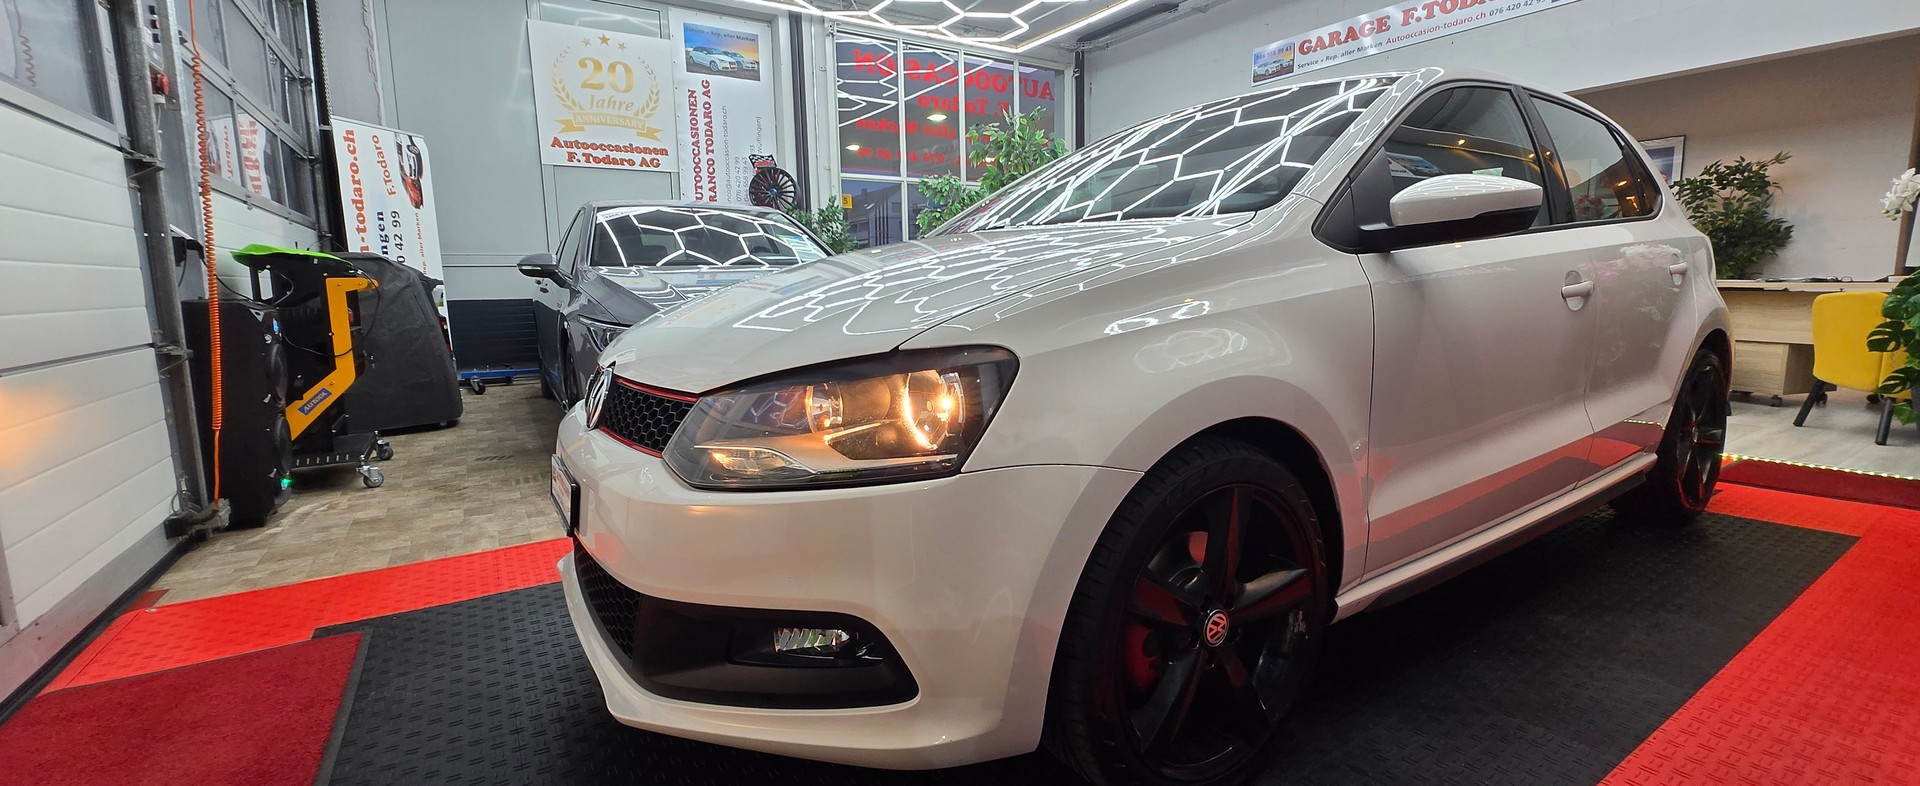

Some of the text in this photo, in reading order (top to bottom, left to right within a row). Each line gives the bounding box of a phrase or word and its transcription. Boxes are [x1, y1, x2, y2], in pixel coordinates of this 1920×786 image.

[1297, 59, 1319, 69] Service
[1325, 54, 1340, 62] Rep.
[1341, 49, 1356, 58] aller
[1356, 42, 1383, 53] Marken
[1385, 11, 1486, 45] Autooccasion-todaro.ch
[1489, 7, 1504, 17] 076
[1505, 2, 1521, 12] 420
[1298, 0, 1487, 55] GARAGE F.TOD
[577, 56, 634, 94] 20
[701, 79, 711, 99] AG
[589, 94, 635, 112] Jahre
[575, 113, 645, 130] ANNIVERSARY
[702, 101, 714, 156] TODARO
[550, 136, 669, 156] Autooccasionen
[722, 105, 731, 202] nco@autooccasion-todaro.ch
[371, 134, 397, 196] F.Todaro
[566, 151, 661, 168] F. Todaro AG
[391, 210, 401, 228] 99
[415, 212, 423, 240] Marken
[393, 233, 404, 251] 42
